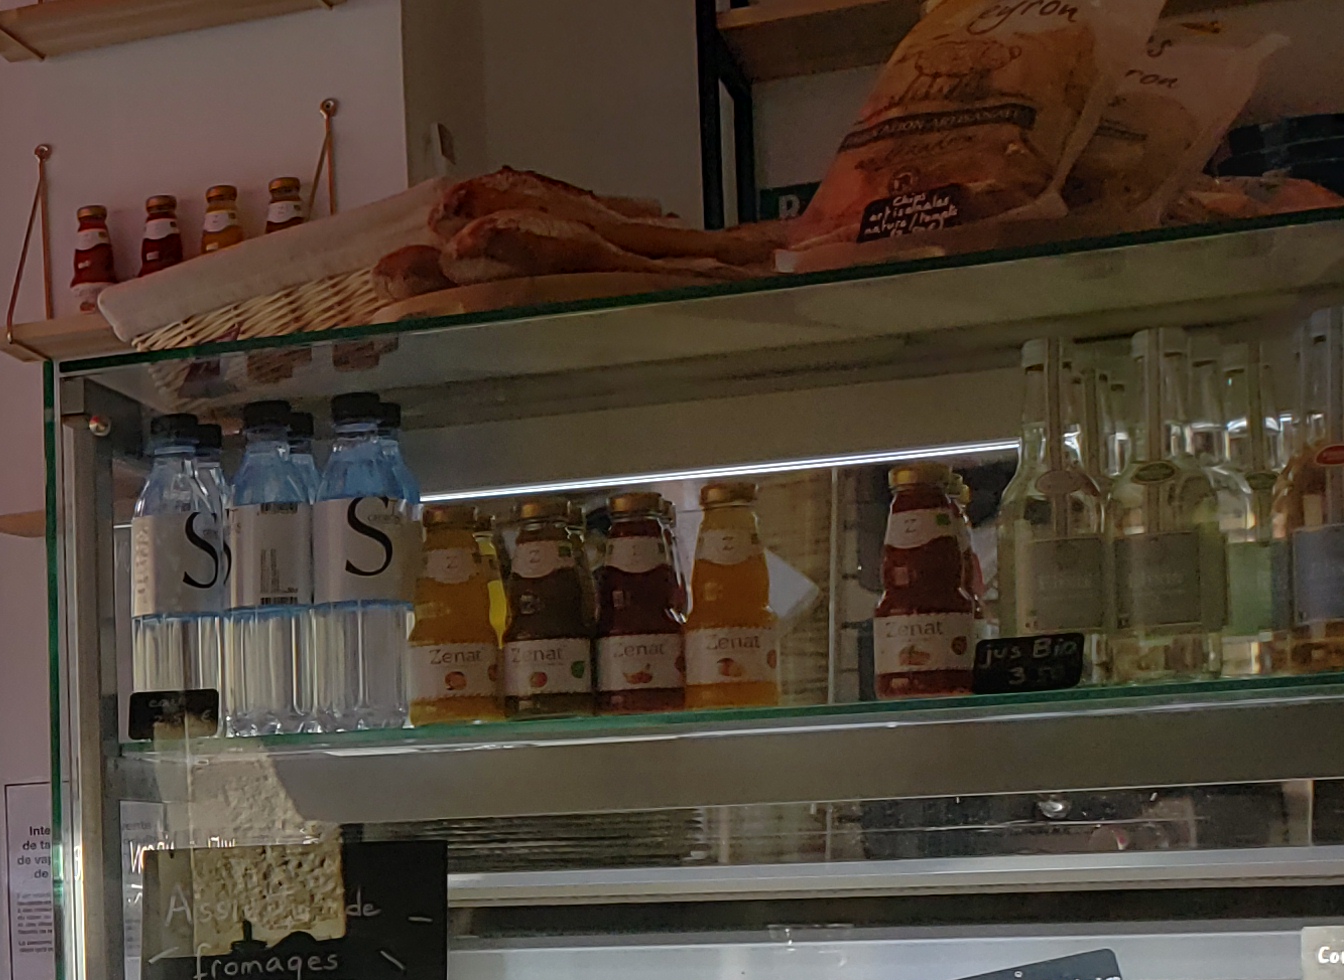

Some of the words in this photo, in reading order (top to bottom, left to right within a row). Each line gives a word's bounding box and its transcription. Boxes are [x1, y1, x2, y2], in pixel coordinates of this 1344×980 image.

[344, 496, 394, 577] S
[977, 643, 1023, 669] jus
[1032, 637, 1078, 659] Bio
[22, 840, 37, 850] de
[17, 855, 31, 865] de
[34, 869, 49, 879] de
[345, 887, 382, 918] de
[1317, 945, 1344, 964] Co
